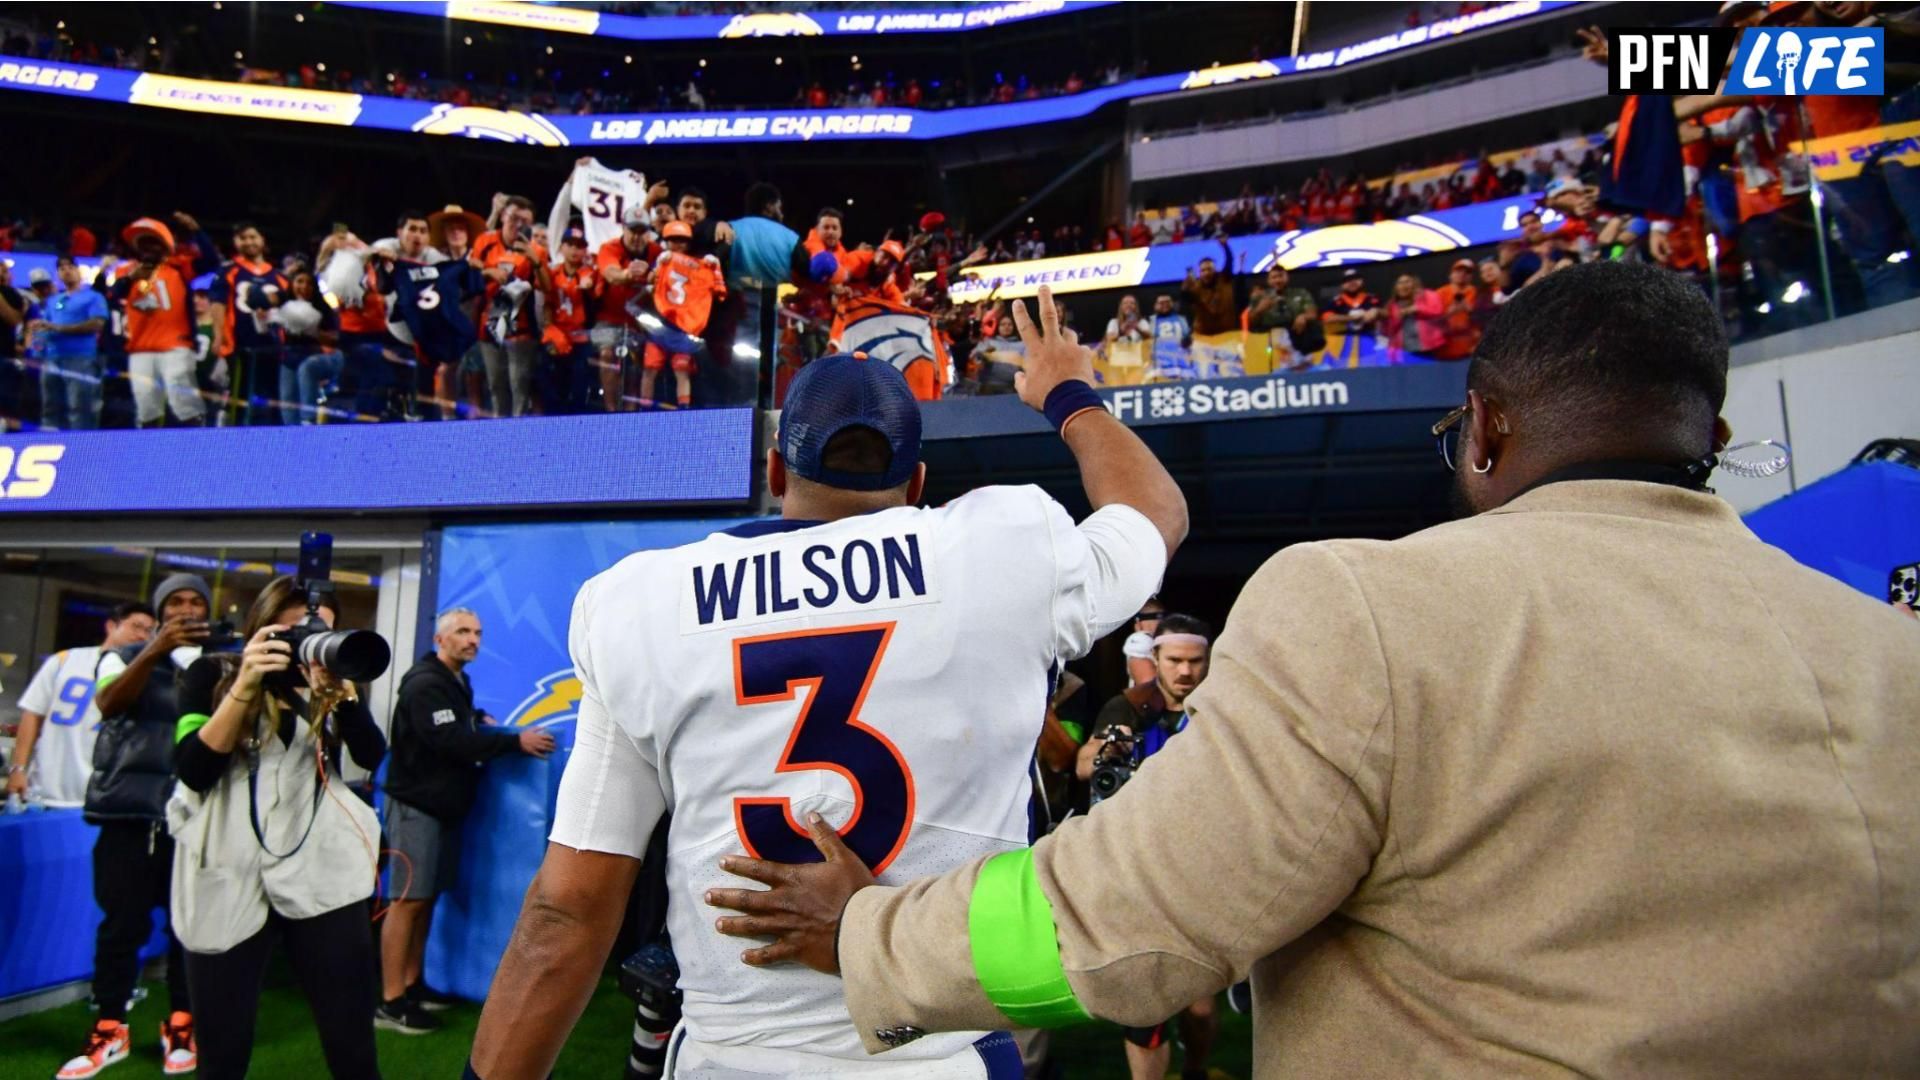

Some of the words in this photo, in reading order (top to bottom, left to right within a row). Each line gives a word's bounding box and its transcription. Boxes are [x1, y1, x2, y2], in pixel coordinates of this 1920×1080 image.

[591, 120, 643, 139] LOS
[644, 117, 767, 144] ANGELES
[770, 115, 912, 141] CHARGERS
[588, 186, 624, 224] 31
[667, 269, 689, 305] 3
[1023, 263, 1122, 286] WEEKEND
[1188, 377, 1350, 414] Stadium
[693, 534, 926, 625] WILSON
[50, 676, 103, 731] 9
[732, 621, 916, 877] 3
